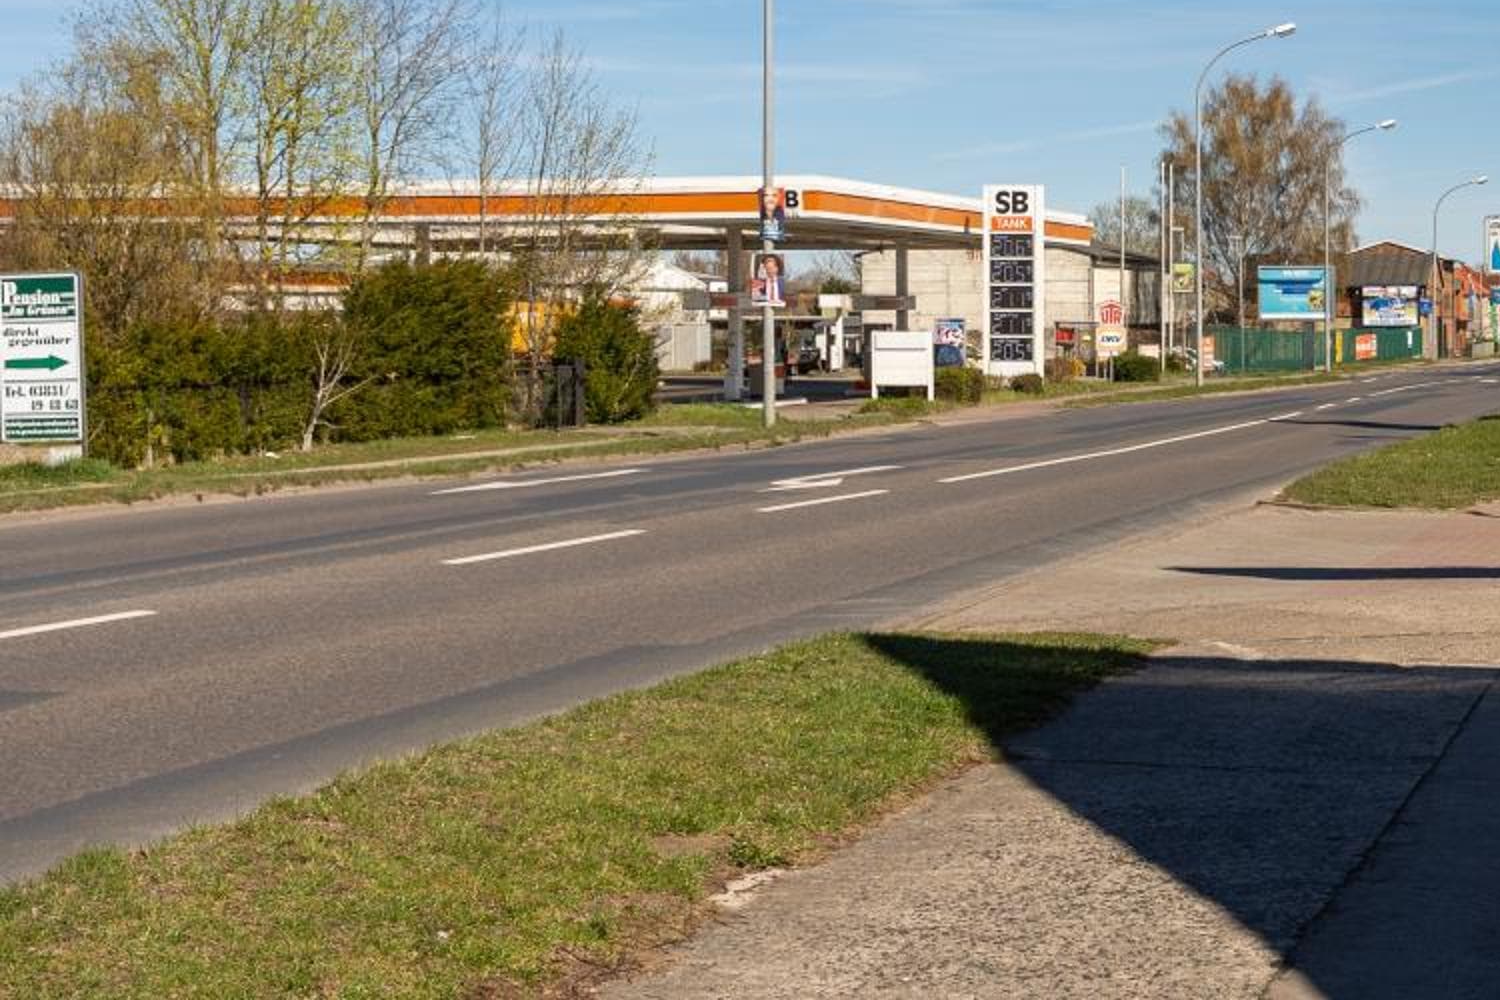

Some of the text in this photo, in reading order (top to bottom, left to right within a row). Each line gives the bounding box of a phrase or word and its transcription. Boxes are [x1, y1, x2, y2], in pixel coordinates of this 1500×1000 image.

[995, 190, 1029, 214] SB
[996, 217, 1028, 230] TANK
[3, 281, 61, 306] Pension
[3, 327, 39, 338] direkt
